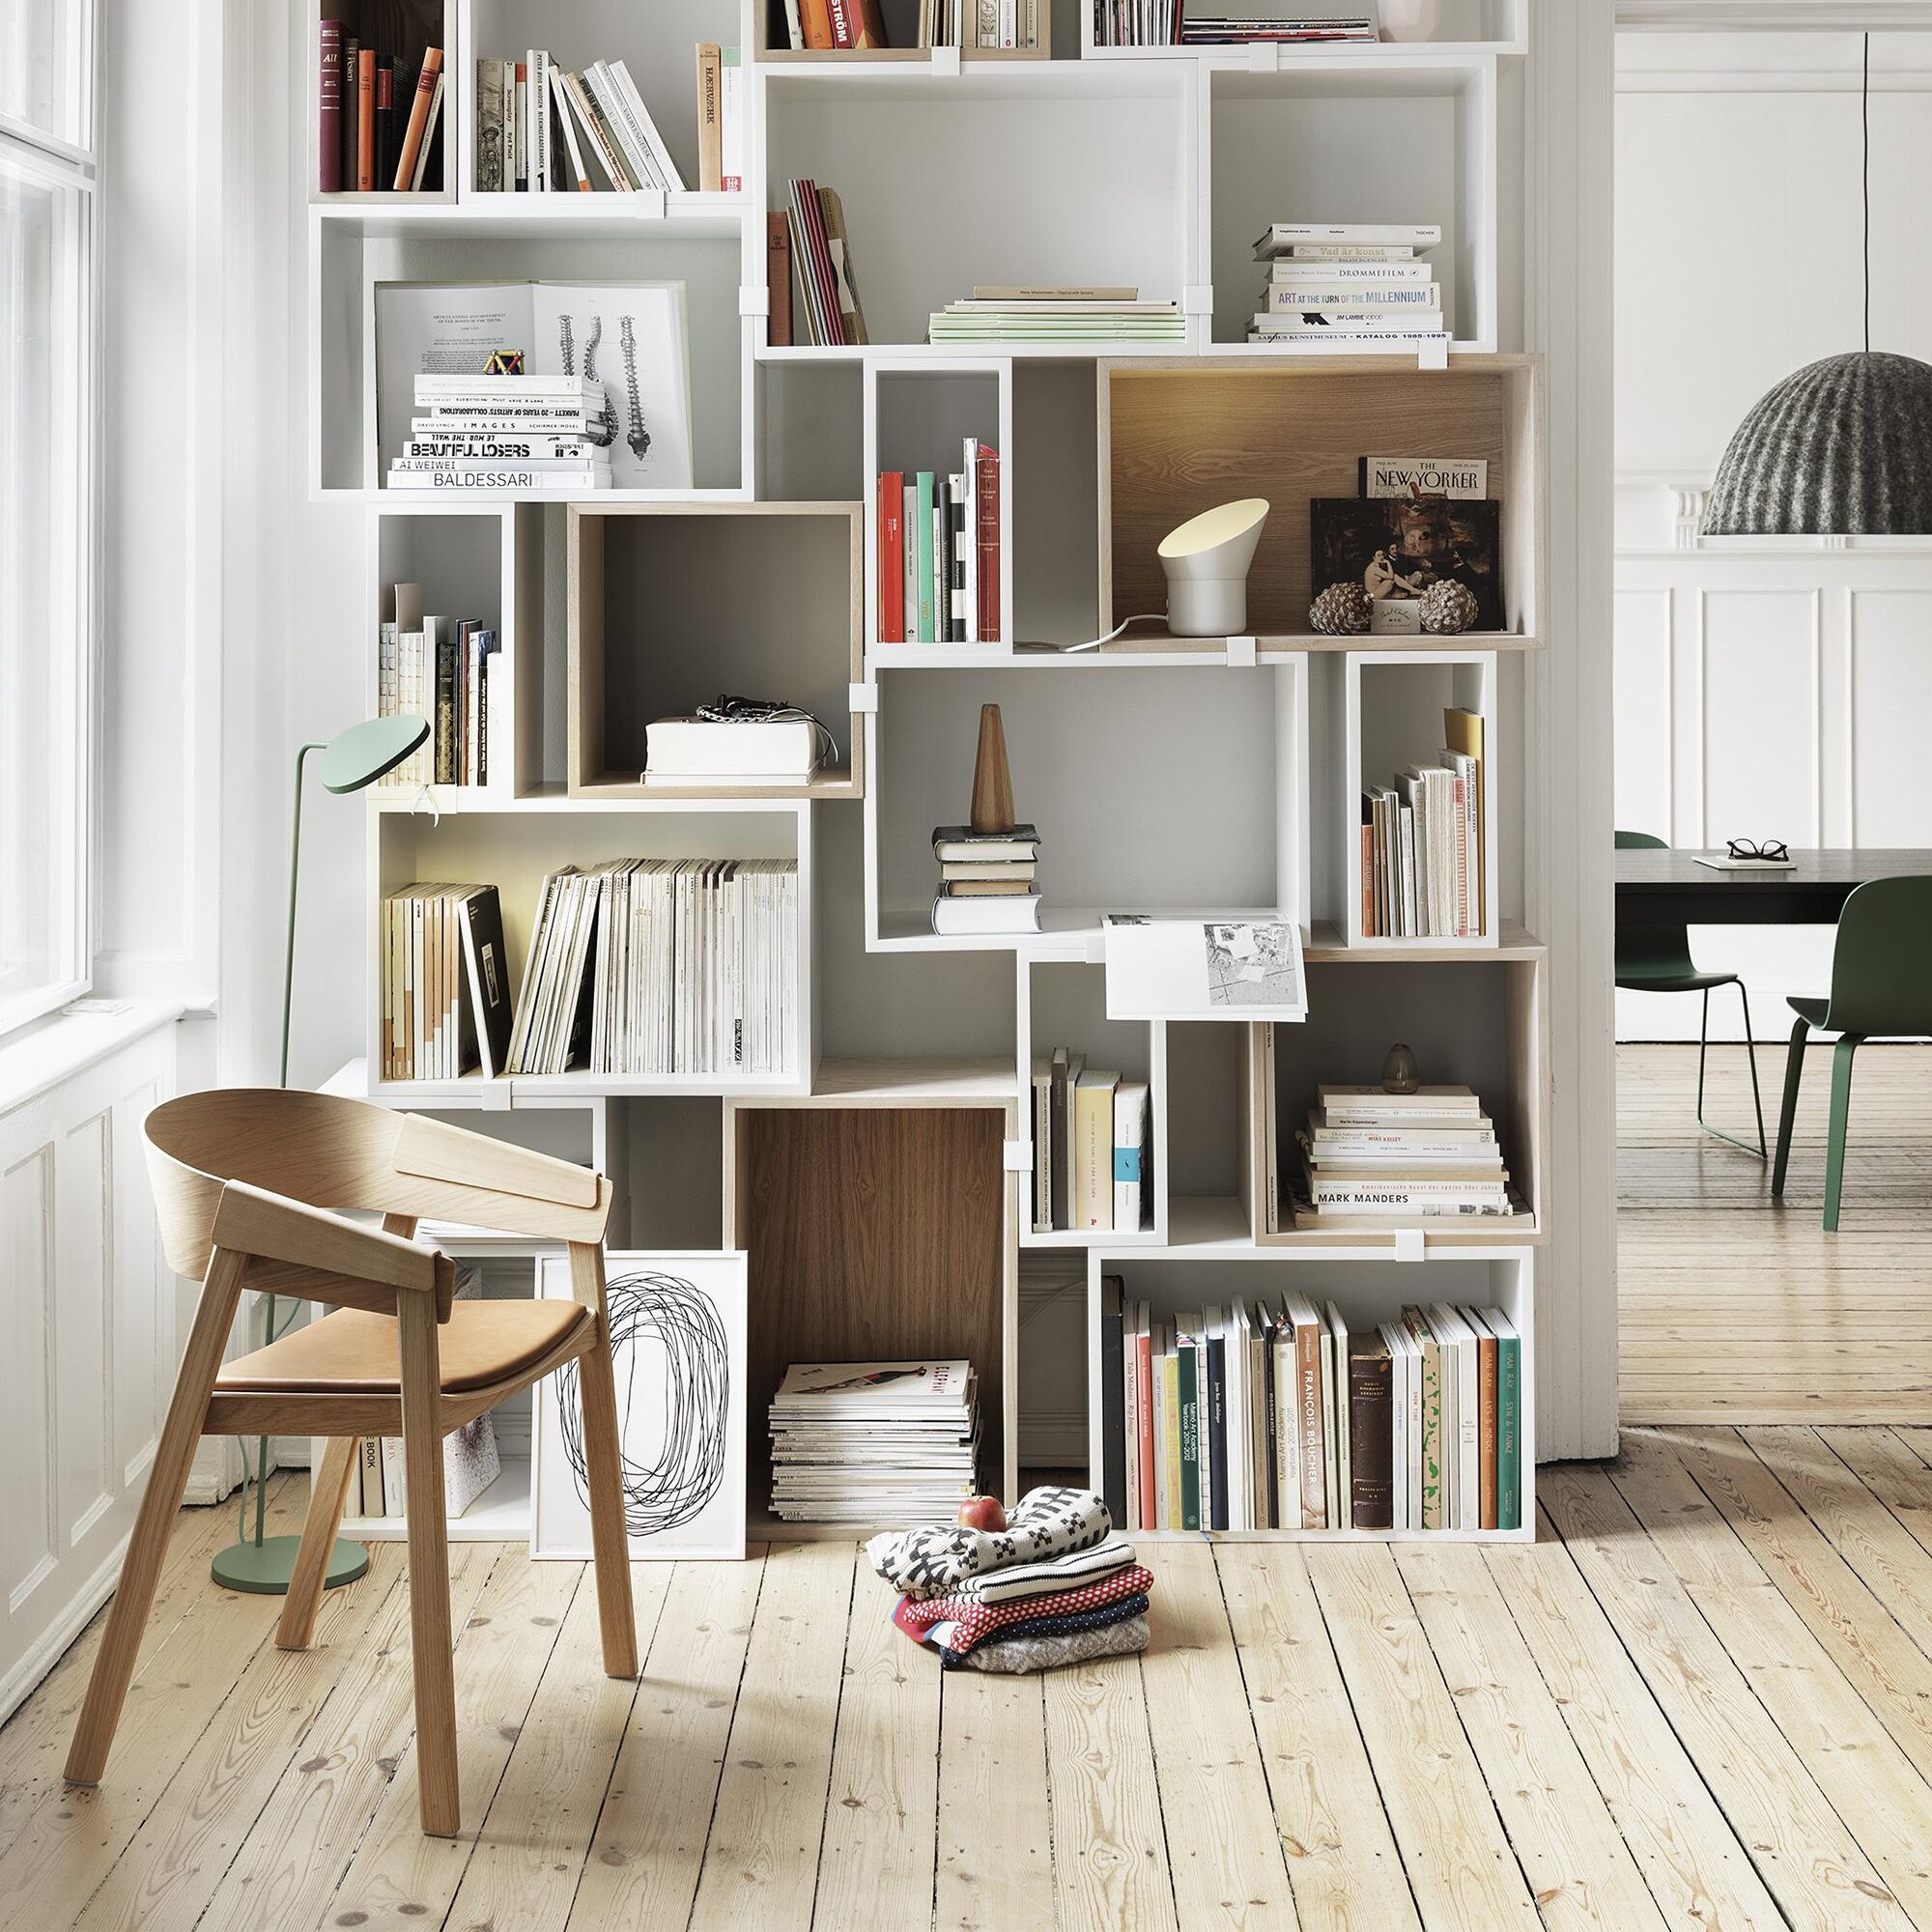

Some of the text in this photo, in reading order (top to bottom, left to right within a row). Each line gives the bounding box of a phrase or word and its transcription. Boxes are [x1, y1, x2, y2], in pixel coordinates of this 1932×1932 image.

[705, 67, 715, 125] HÆRVÆRK
[1320, 247, 1340, 256] Vad
[1355, 247, 1385, 256] konst
[1339, 269, 1406, 277] DRØMMEFILM
[1278, 291, 1426, 304] ART AT THE TURN OF THE MILLENNIUM
[481, 443, 530, 457] LOSERS
[400, 461, 455, 469] AI WEIWEI
[434, 472, 532, 487] BALDESSARI
[1376, 470, 1478, 489] NEW YORKER
[1319, 1194, 1408, 1203] MARK MANDERS
[1304, 1370, 1315, 1427] FRANÇOIS
[366, 1441, 376, 1468] BOOK
[1307, 1431, 1317, 1484] BOUCHER
